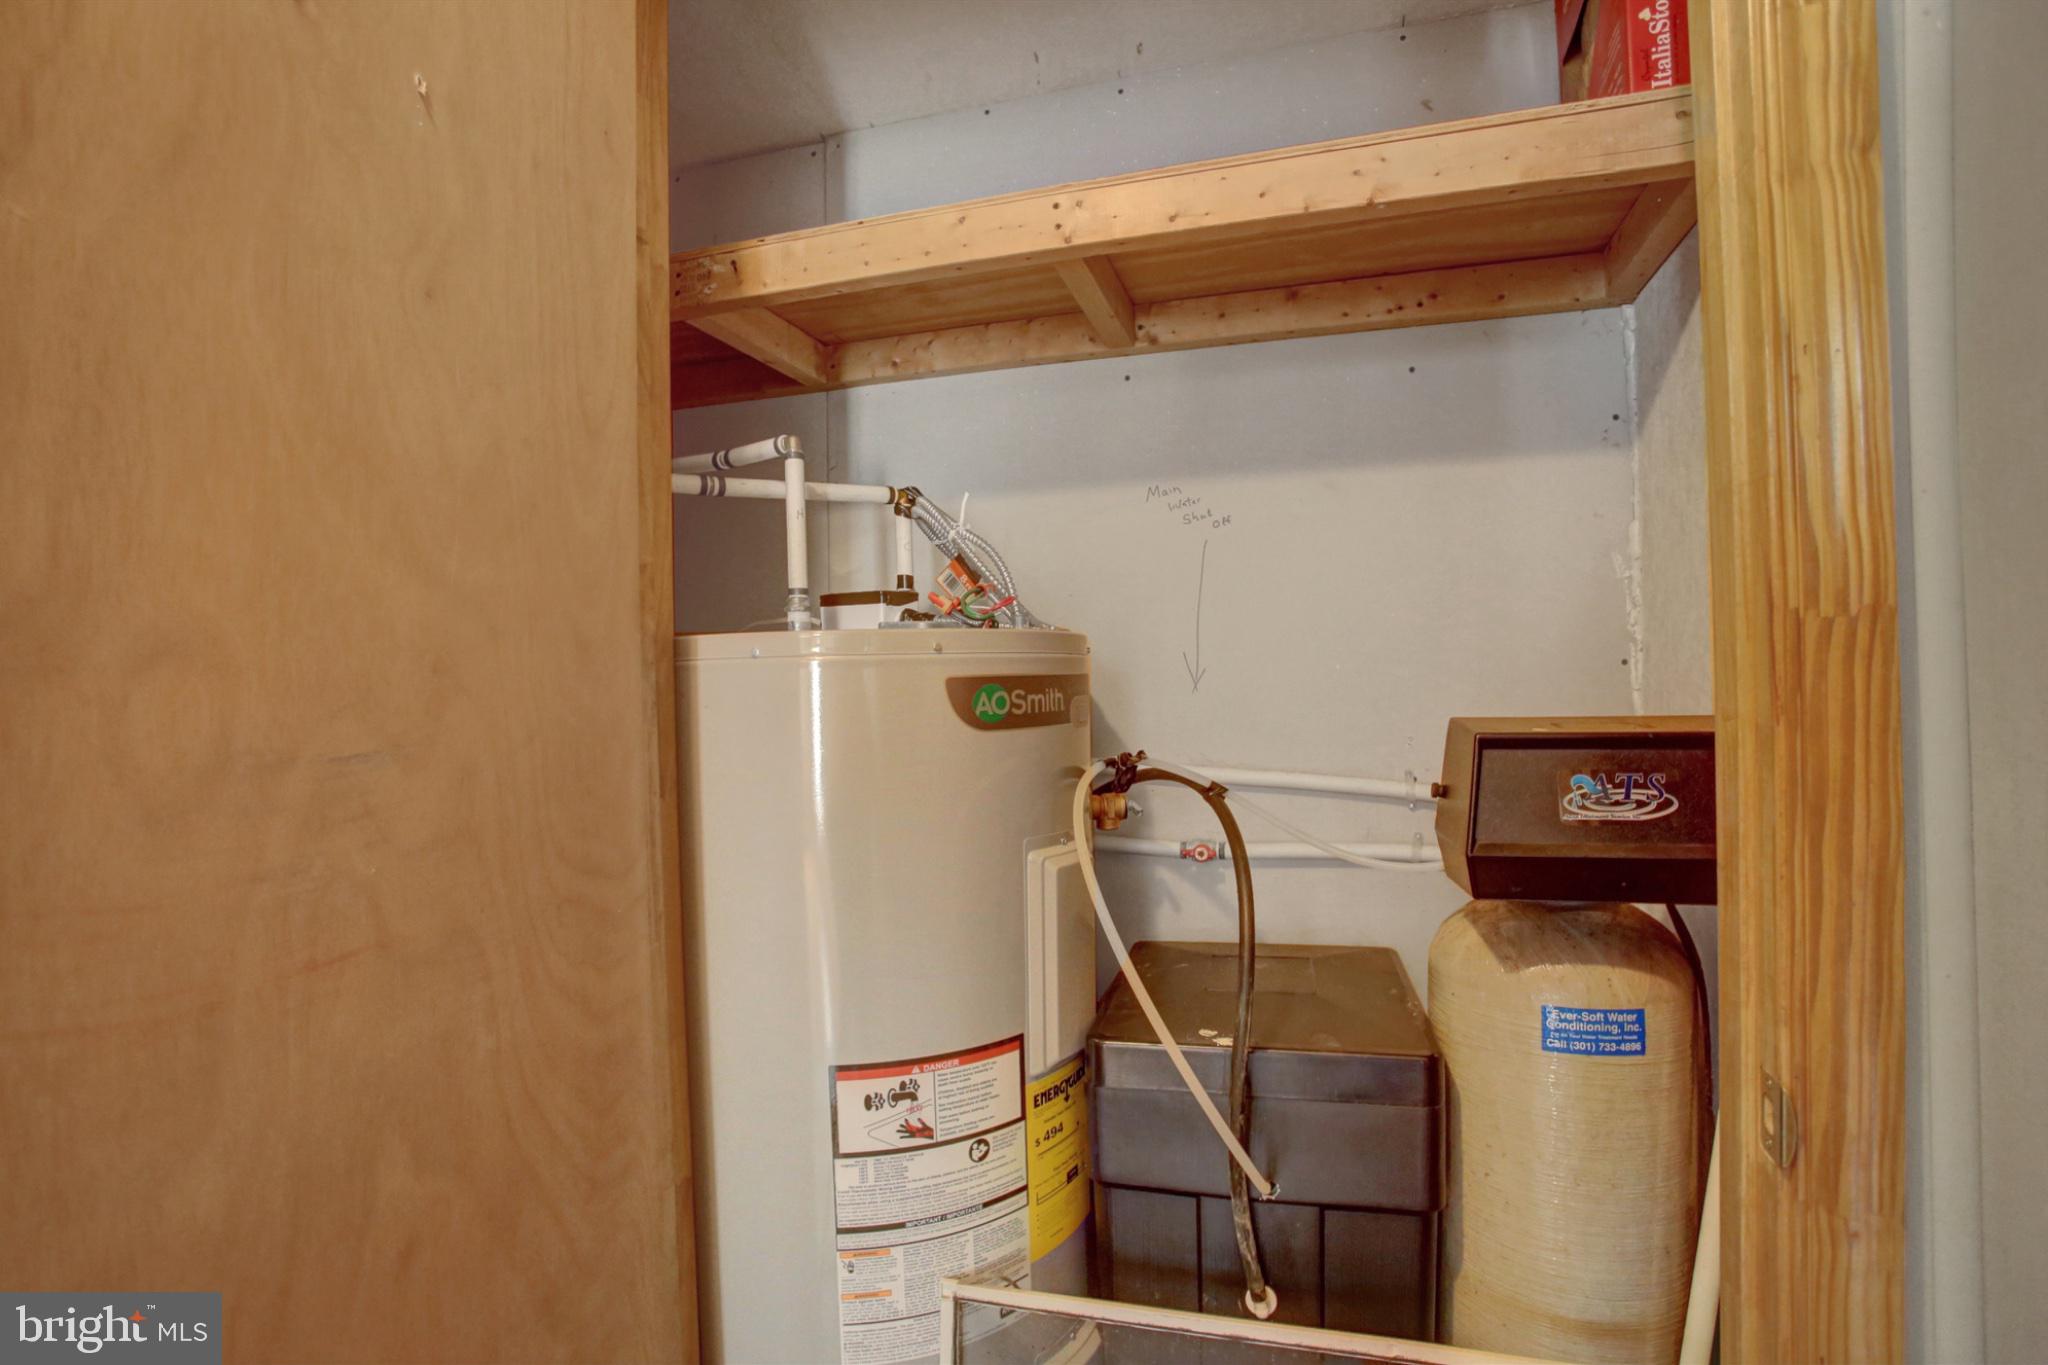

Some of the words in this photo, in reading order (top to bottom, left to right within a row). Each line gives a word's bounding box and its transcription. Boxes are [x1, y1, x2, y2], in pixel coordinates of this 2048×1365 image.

[1146, 485, 1182, 502] Main
[1182, 508, 1212, 525] Shut
[1551, 1009, 1604, 1022] Ever-Soft
[1607, 1012, 1637, 1022] Water
[1624, 1023, 1642, 1032] Inc.
[1546, 1038, 1567, 1049] Call
[1569, 1041, 1596, 1052] (301)
[923, 1059, 960, 1073] DANGER
[1043, 1121, 1064, 1141] 494
